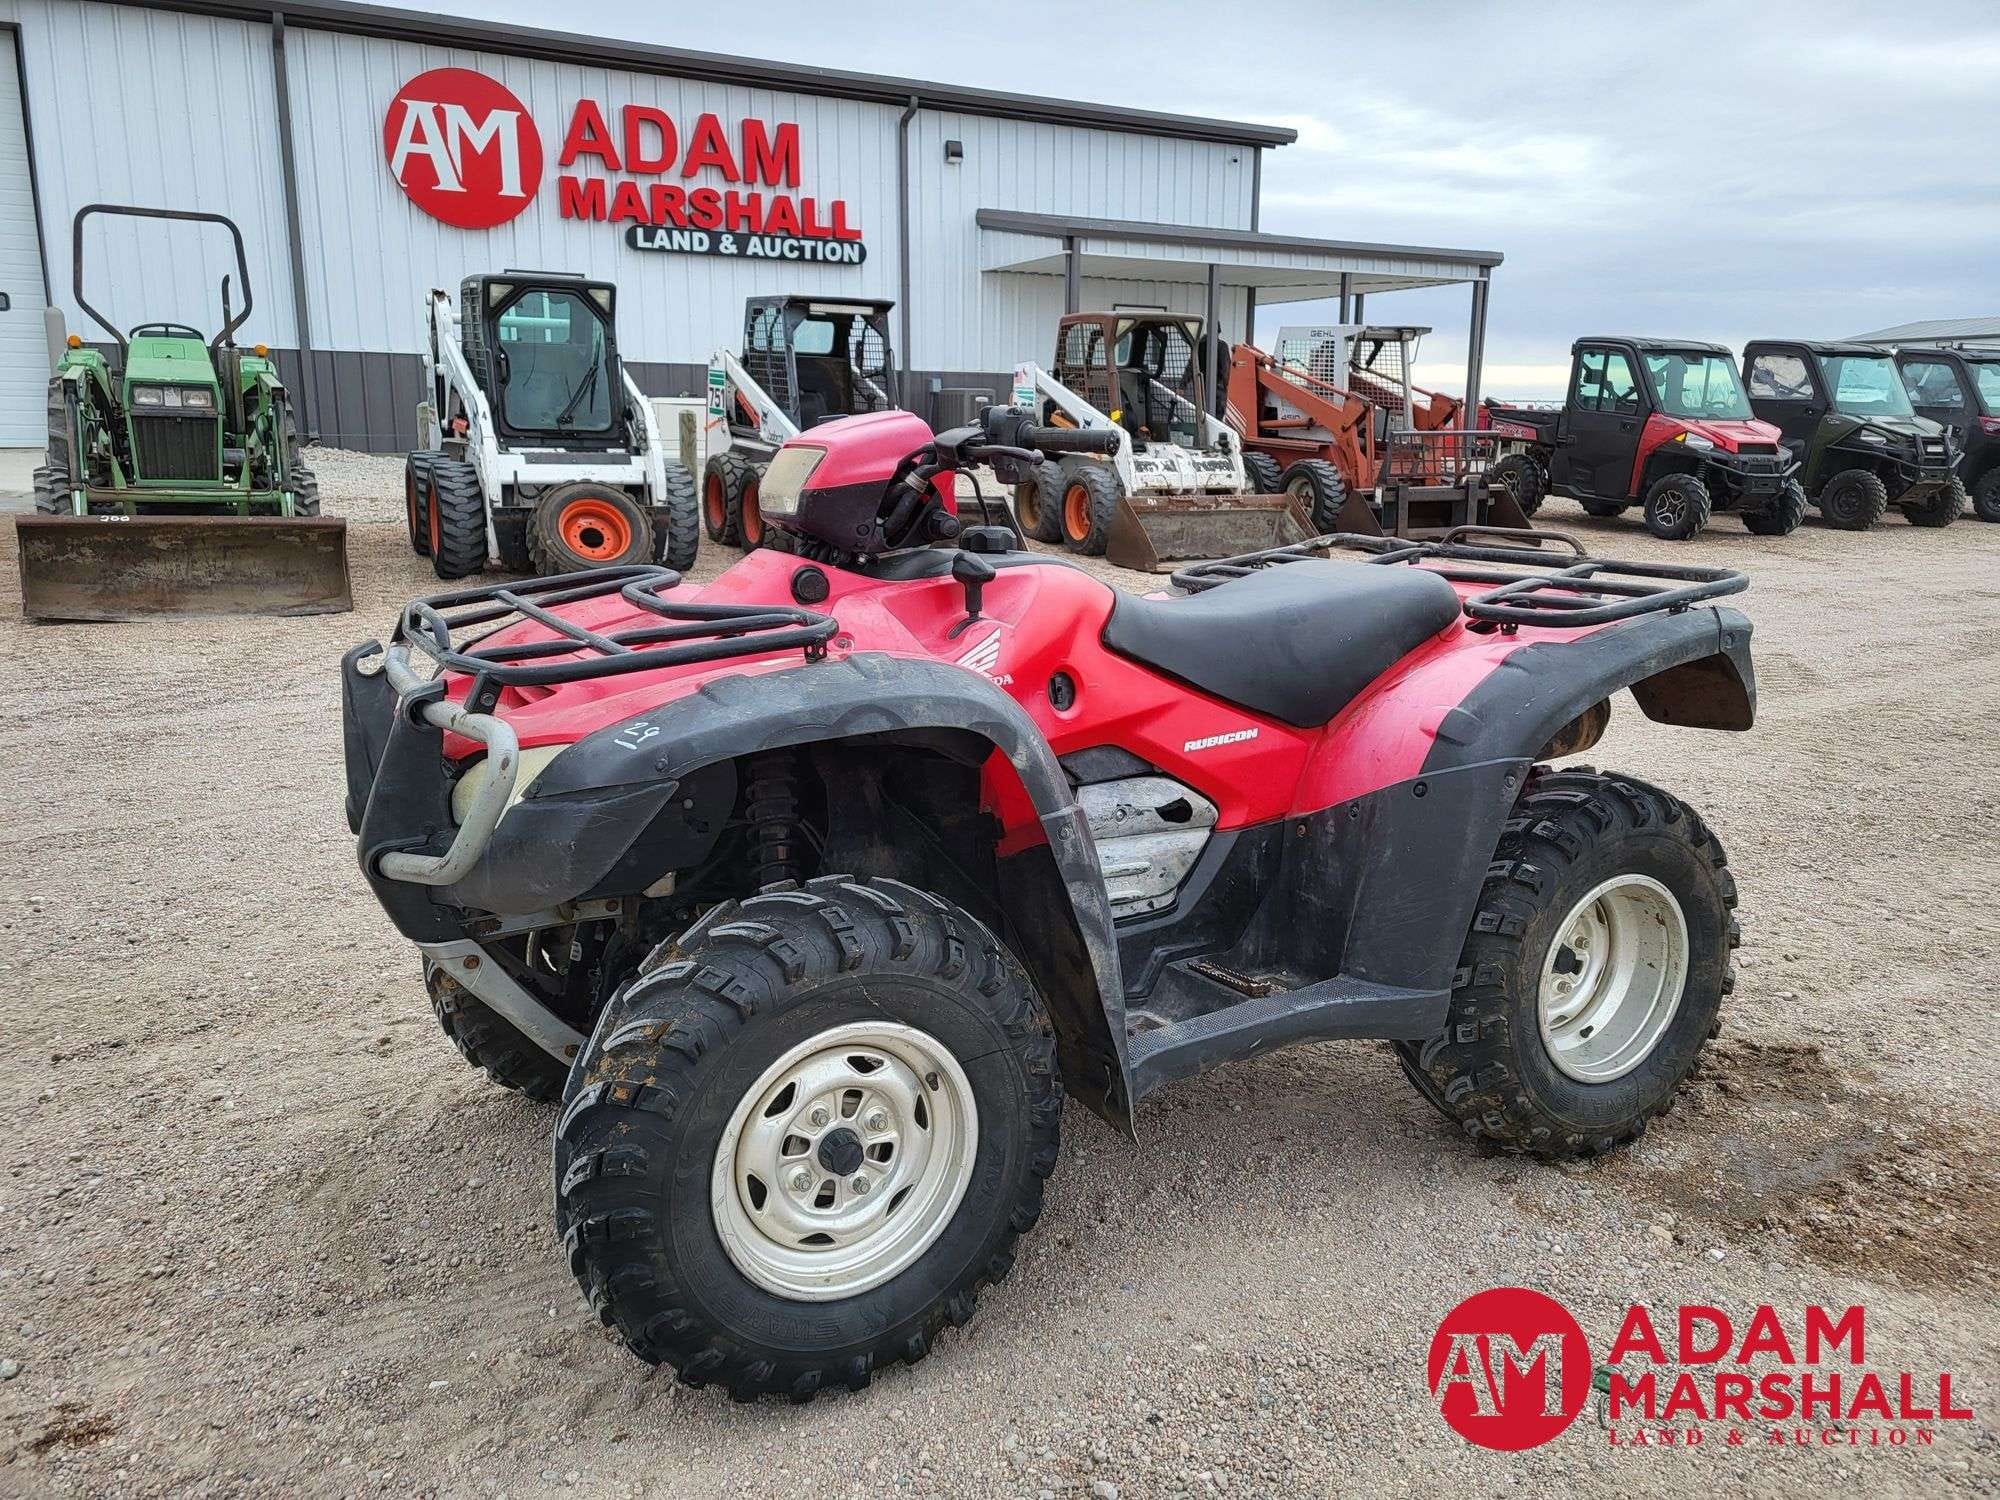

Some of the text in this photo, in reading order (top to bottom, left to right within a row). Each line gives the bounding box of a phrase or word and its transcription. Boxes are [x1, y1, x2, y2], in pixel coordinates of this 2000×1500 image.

[558, 98, 800, 188] ADAM
[558, 175, 862, 240] MARSHALL
[636, 228, 860, 263] LAND & AUCTION
[1310, 329, 1335, 337] GEHL
[709, 387, 725, 408] 751
[1183, 728, 1258, 752] RUBICON
